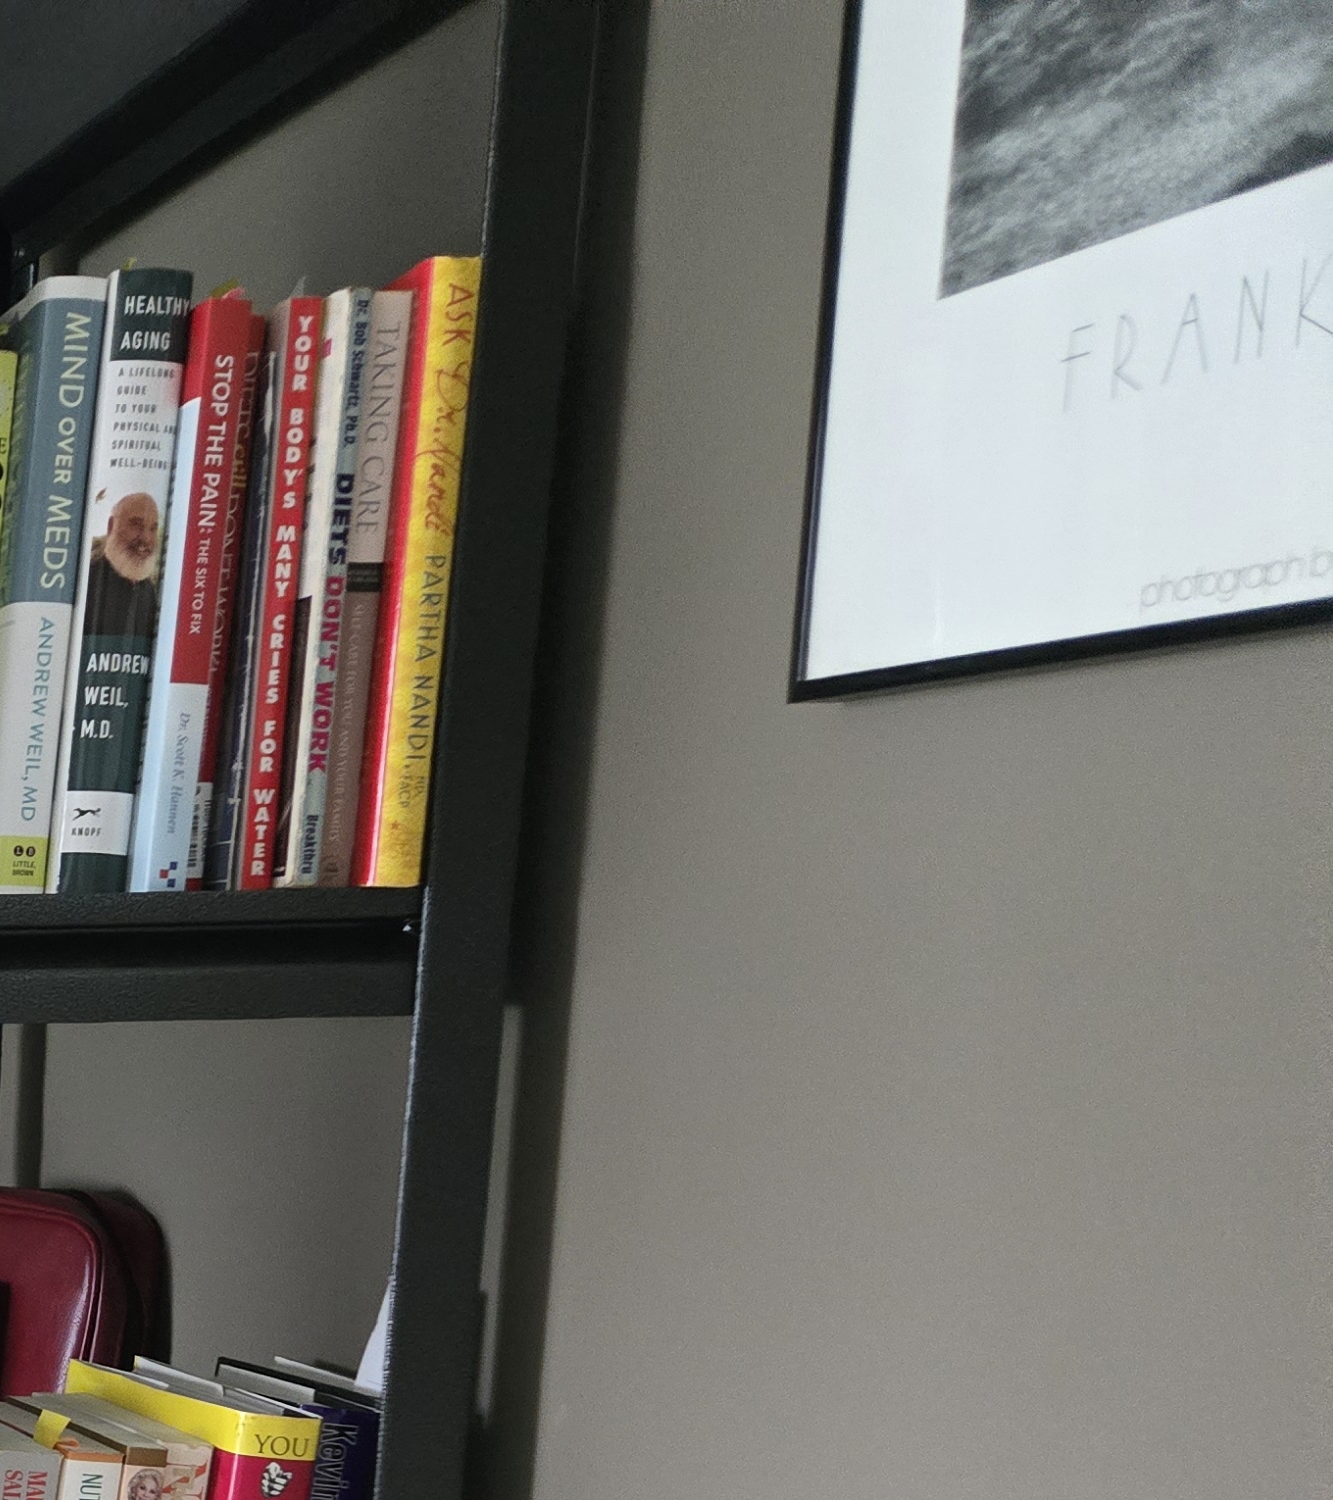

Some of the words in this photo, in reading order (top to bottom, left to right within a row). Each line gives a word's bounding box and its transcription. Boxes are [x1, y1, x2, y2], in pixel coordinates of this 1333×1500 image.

[124, 295, 193, 316] HEALTHY
[58, 311, 95, 408] MIND
[120, 331, 170, 351] AGING
[53, 416, 80, 486] OVER
[40, 494, 72, 590] MEDS
[71, 826, 103, 838] KNOPF
